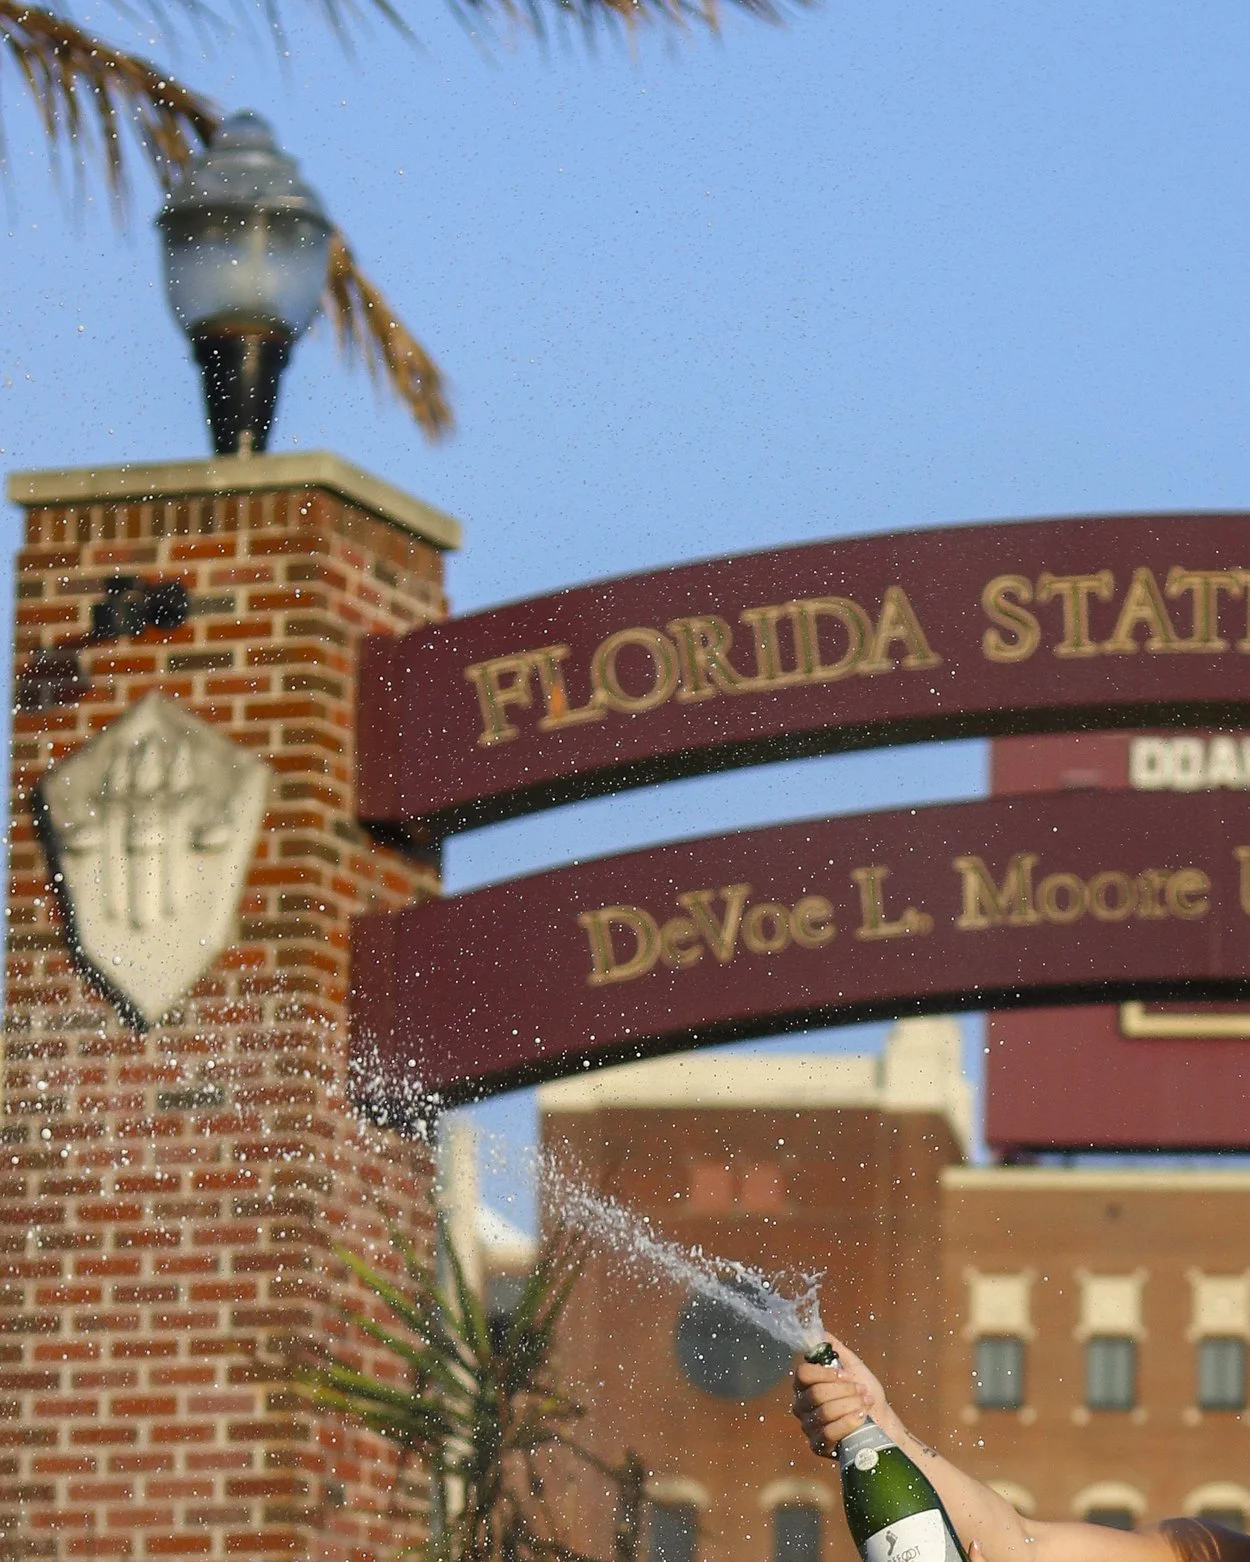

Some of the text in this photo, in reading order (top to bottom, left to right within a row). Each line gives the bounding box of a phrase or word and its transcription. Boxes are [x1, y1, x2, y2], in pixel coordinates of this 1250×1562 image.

[465, 586, 941, 746] FLORIDA
[580, 884, 837, 985] DeVoe
[852, 866, 934, 940] L.
[953, 854, 1211, 930] Moore
